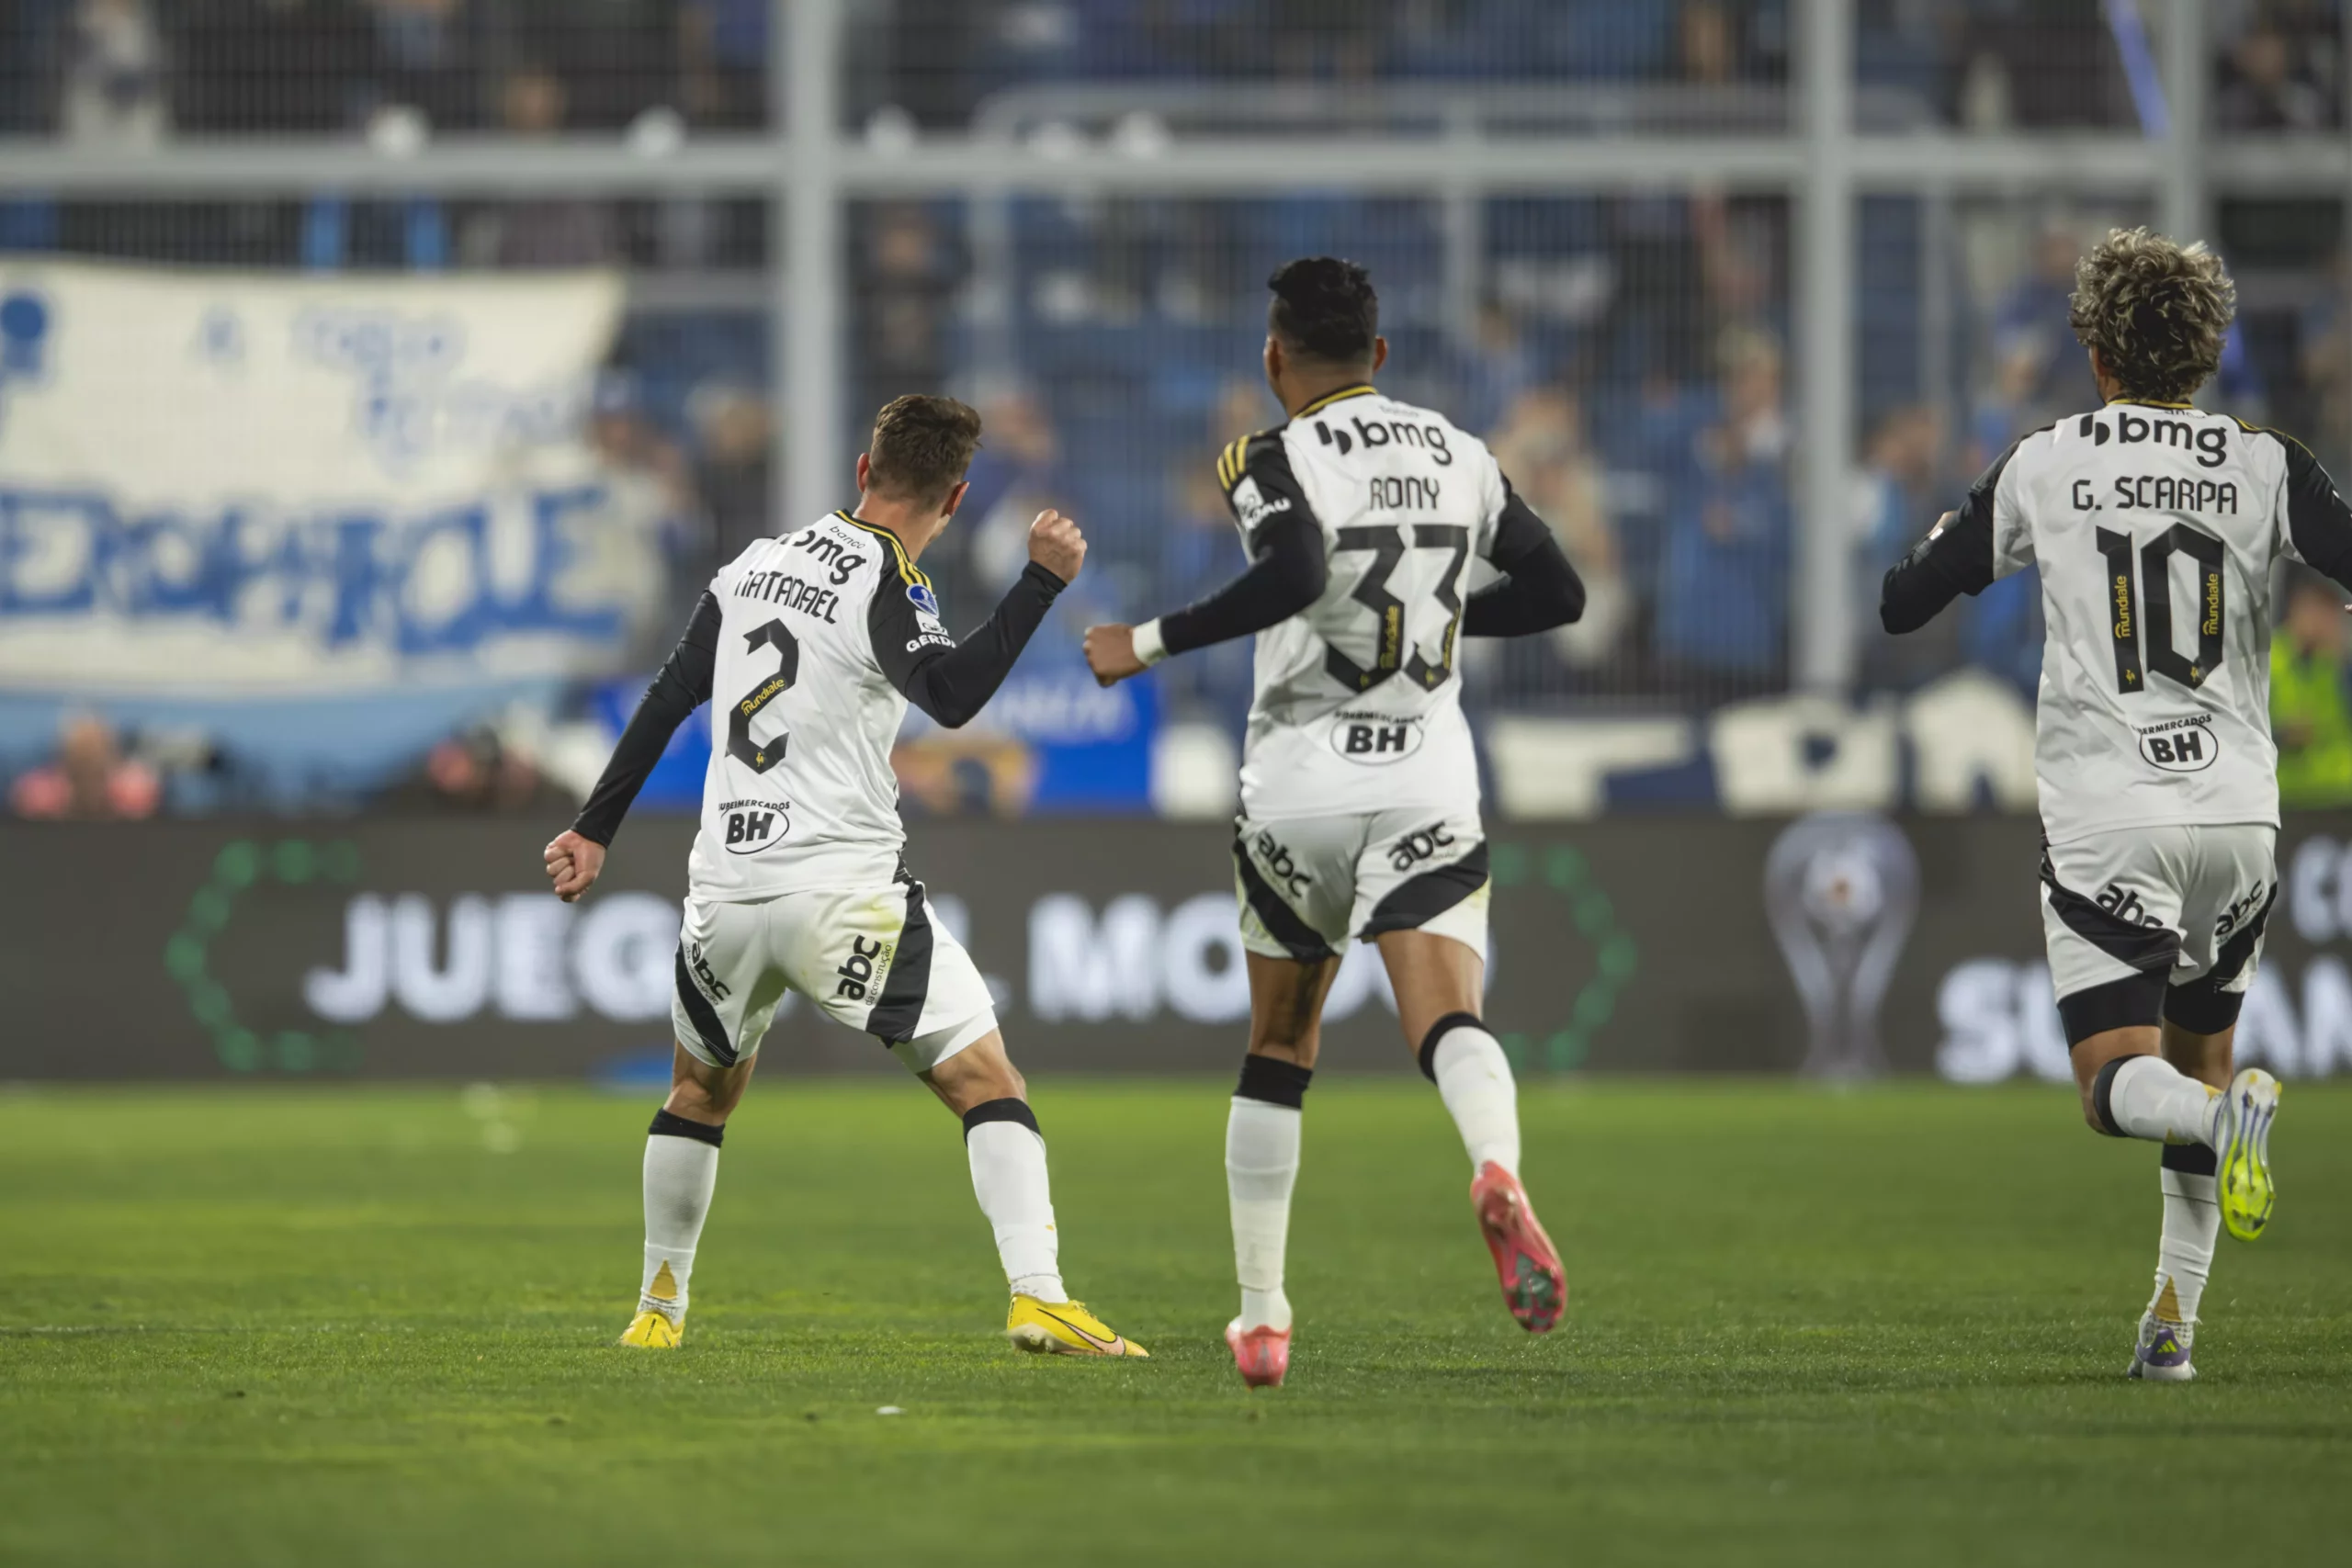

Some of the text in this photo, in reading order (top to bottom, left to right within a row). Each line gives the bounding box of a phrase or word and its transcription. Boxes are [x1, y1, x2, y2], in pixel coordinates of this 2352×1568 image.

[1351, 417, 1453, 467] bmg
[2119, 412, 2227, 468] bmg
[1370, 476, 1442, 511] RONY
[2072, 475, 2237, 514] G. SCARPA
[829, 525, 866, 549] banco
[1326, 524, 1470, 694] 33
[2096, 522, 2225, 694] 10
[2114, 575, 2131, 639] mundiale
[2202, 573, 2219, 636] mundiale
[724, 617, 800, 775] 2
[741, 677, 787, 716] mundiale
[1345, 725, 1408, 753] BH
[2147, 730, 2203, 763] BH
[725, 810, 775, 845] BH
[1386, 820, 1455, 873] abc
[1259, 830, 1311, 898] abc
[2214, 878, 2263, 937] abc
[692, 942, 732, 1001] abc
[837, 934, 882, 1001] abc
[865, 944, 892, 1006] da construção
